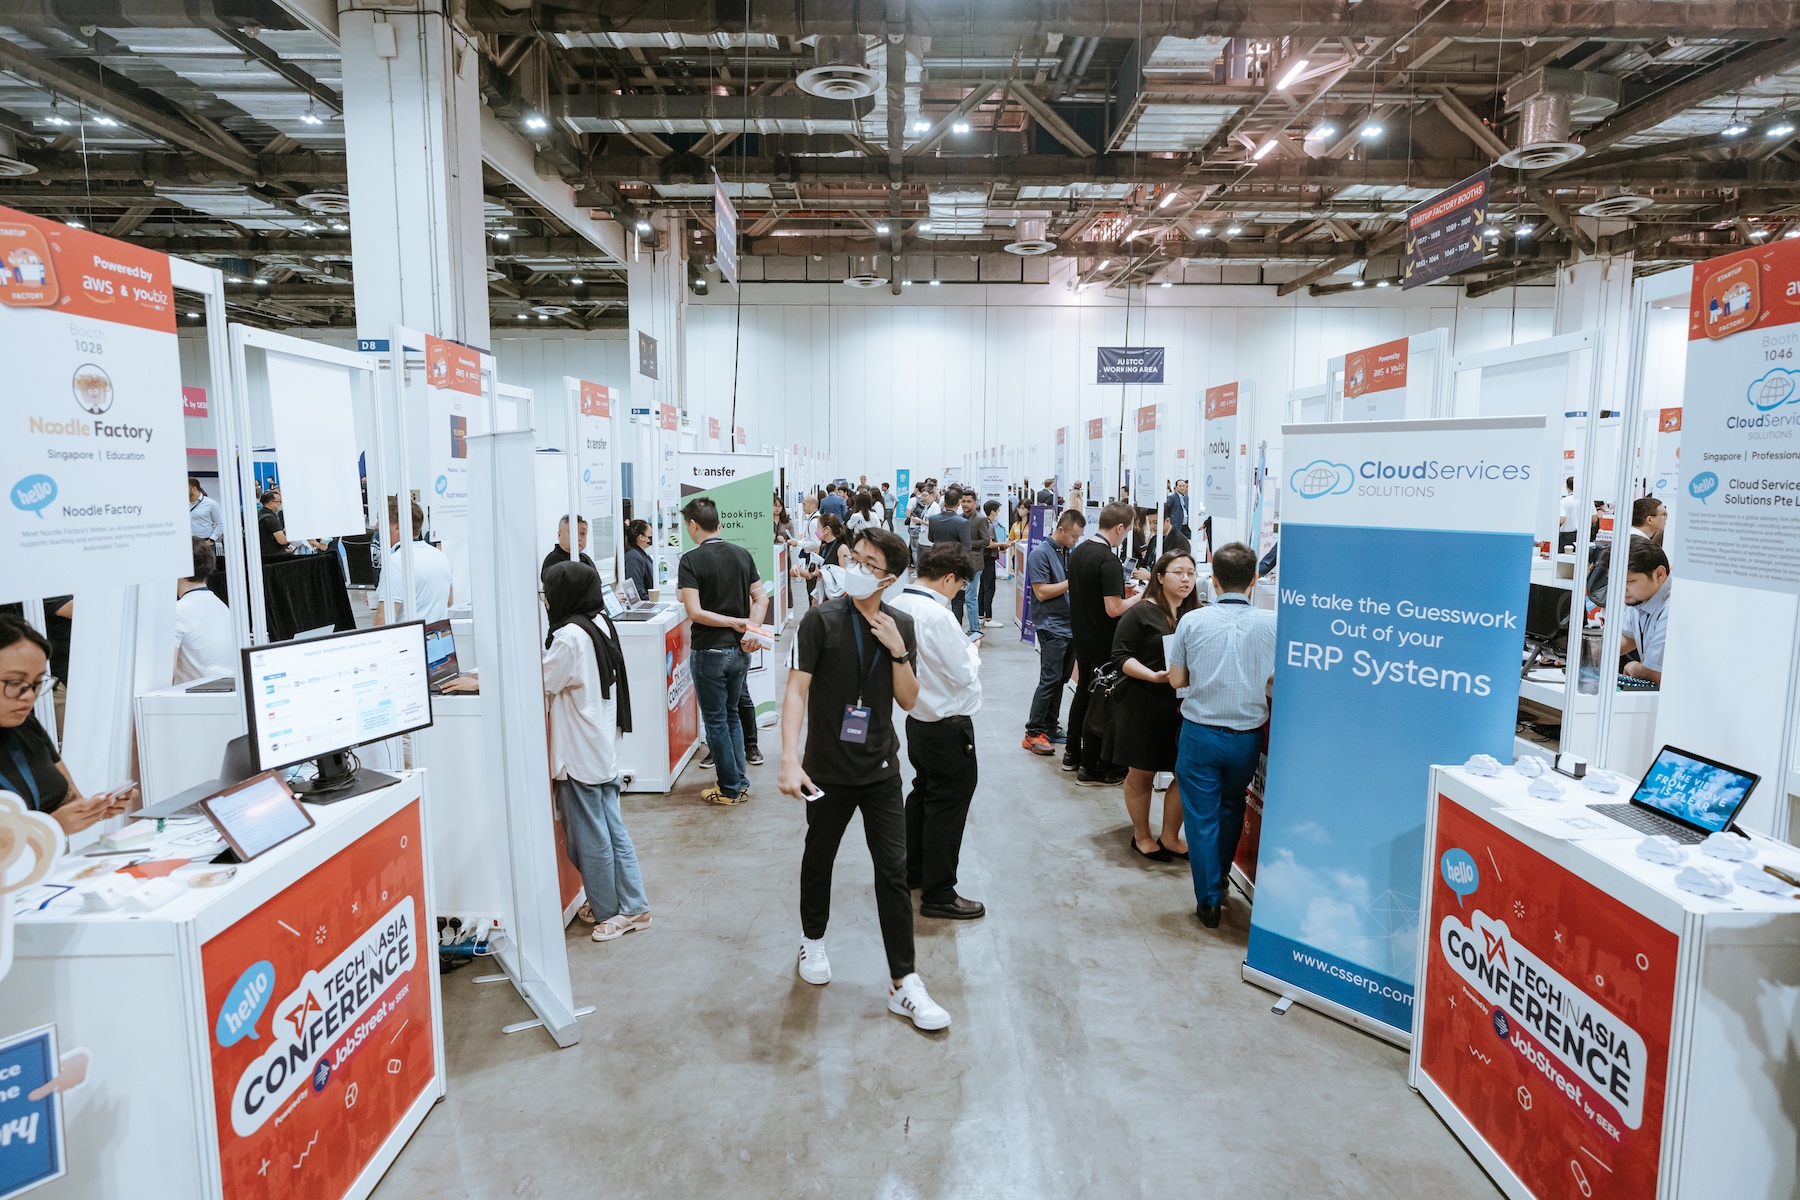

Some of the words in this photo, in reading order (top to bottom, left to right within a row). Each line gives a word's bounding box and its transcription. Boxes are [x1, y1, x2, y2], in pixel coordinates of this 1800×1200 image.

[1432, 200, 1457, 216] FACTORY
[1458, 186, 1482, 204] BOOTHS
[94, 256, 139, 277] Powered
[140, 268, 152, 283] by
[1717, 266, 1742, 282] STARTUP
[82, 275, 114, 295] aws
[120, 285, 128, 296] &
[133, 286, 168, 305] youbiz
[70, 323, 105, 339] Booth
[1718, 318, 1744, 332] FACTORY
[75, 339, 103, 355] 1028
[362, 342, 376, 350] D8
[1762, 333, 1798, 348] Booth
[1764, 348, 1793, 361] 1046
[190, 401, 196, 409] by
[29, 416, 90, 436] Noodle
[94, 421, 153, 442] Factory
[1748, 430, 1792, 440] SOLUTIONS
[48, 450, 94, 461] Singapore
[106, 451, 145, 460] Education
[1209, 437, 1230, 459] norby
[1703, 452, 1741, 462] Singapore
[693, 467, 735, 476] transfer
[1360, 460, 1530, 480] CloudServices
[17, 481, 52, 505] hello
[1358, 485, 1435, 498] SOLUTIONS
[1693, 478, 1714, 493] hello
[1729, 478, 1759, 489] Cloud
[62, 506, 102, 517] Noodle
[105, 504, 142, 515] Factory
[1725, 494, 1771, 505] Solutions
[1774, 495, 1793, 506] Pte
[721, 510, 765, 519] bookings.
[1281, 588, 1306, 606] We
[1311, 592, 1353, 611] take
[1358, 597, 1390, 615] the
[1396, 600, 1517, 629] Guesswork
[1331, 620, 1366, 638] Out
[1372, 625, 1393, 641] of
[1398, 630, 1444, 649] your
[1288, 640, 1343, 671] ERP
[1352, 650, 1492, 697] Systems
[1655, 774, 1687, 791] FROM
[1688, 787, 1728, 808] ABOVE
[1695, 778, 1715, 792] VIE
[1660, 786, 1672, 796] IS
[1675, 792, 1710, 811] CLER
[1446, 858, 1474, 884] hello
[1293, 950, 1414, 1006] www.csserp.com
[224, 973, 267, 1034] hello
[1462, 986, 1483, 1011] Powered
[1482, 1004, 1489, 1015] by
[244, 934, 410, 1115] CONFERENCE
[332, 1002, 387, 1071] JobStreet
[388, 1000, 395, 1012] by
[396, 985, 409, 1004] SEEK
[1448, 930, 1630, 1108] CONFERENCE
[1510, 1030, 1582, 1106] JobStreet
[1584, 1102, 1595, 1119] by
[1596, 1113, 1620, 1142] SEEK
[275, 1096, 301, 1126] Powered
[301, 1089, 308, 1103] by
[0, 1112, 39, 1146] ry
